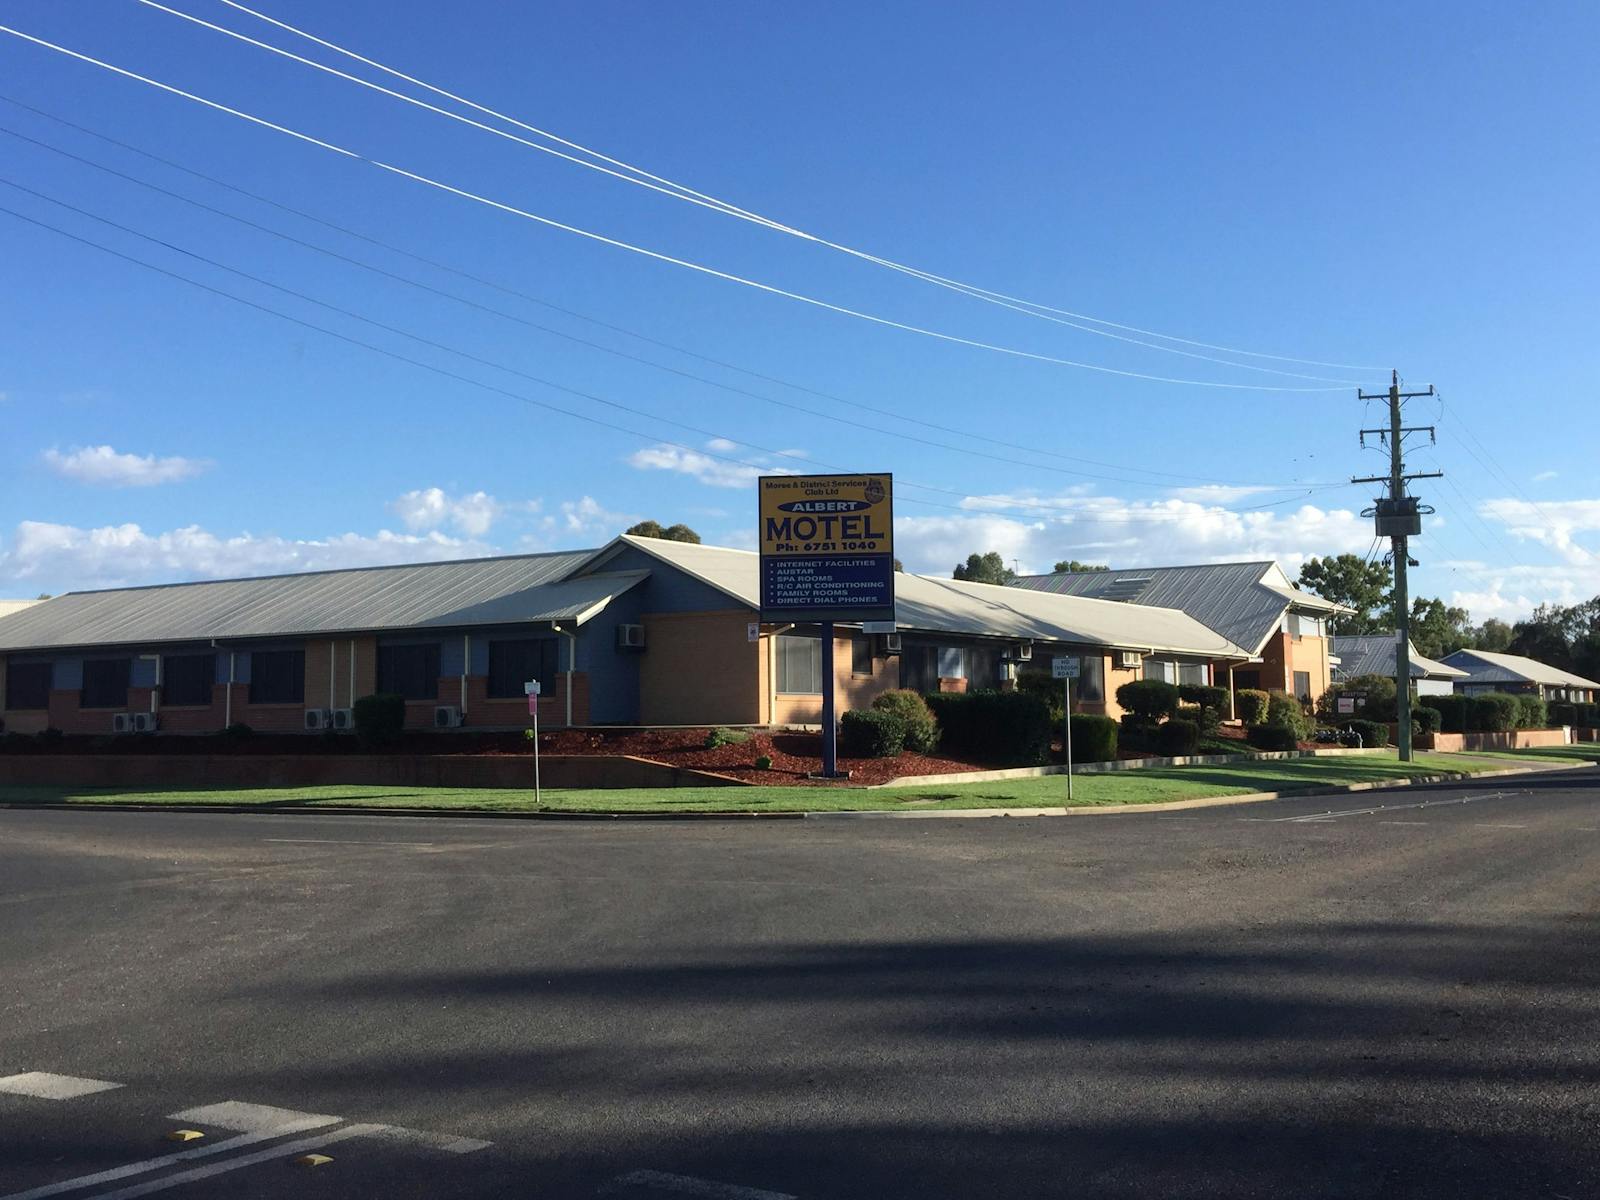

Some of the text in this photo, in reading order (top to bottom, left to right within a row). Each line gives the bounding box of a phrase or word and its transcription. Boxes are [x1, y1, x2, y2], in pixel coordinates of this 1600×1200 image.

[800, 480, 830, 488] District
[832, 479, 867, 487] Services
[804, 488, 839, 496] Club Ltd
[791, 501, 858, 512] ALBERT
[766, 515, 885, 541] MOTEL
[776, 541, 877, 552] Ph: 6751 1040
[814, 581, 885, 589] CONDITIONING
